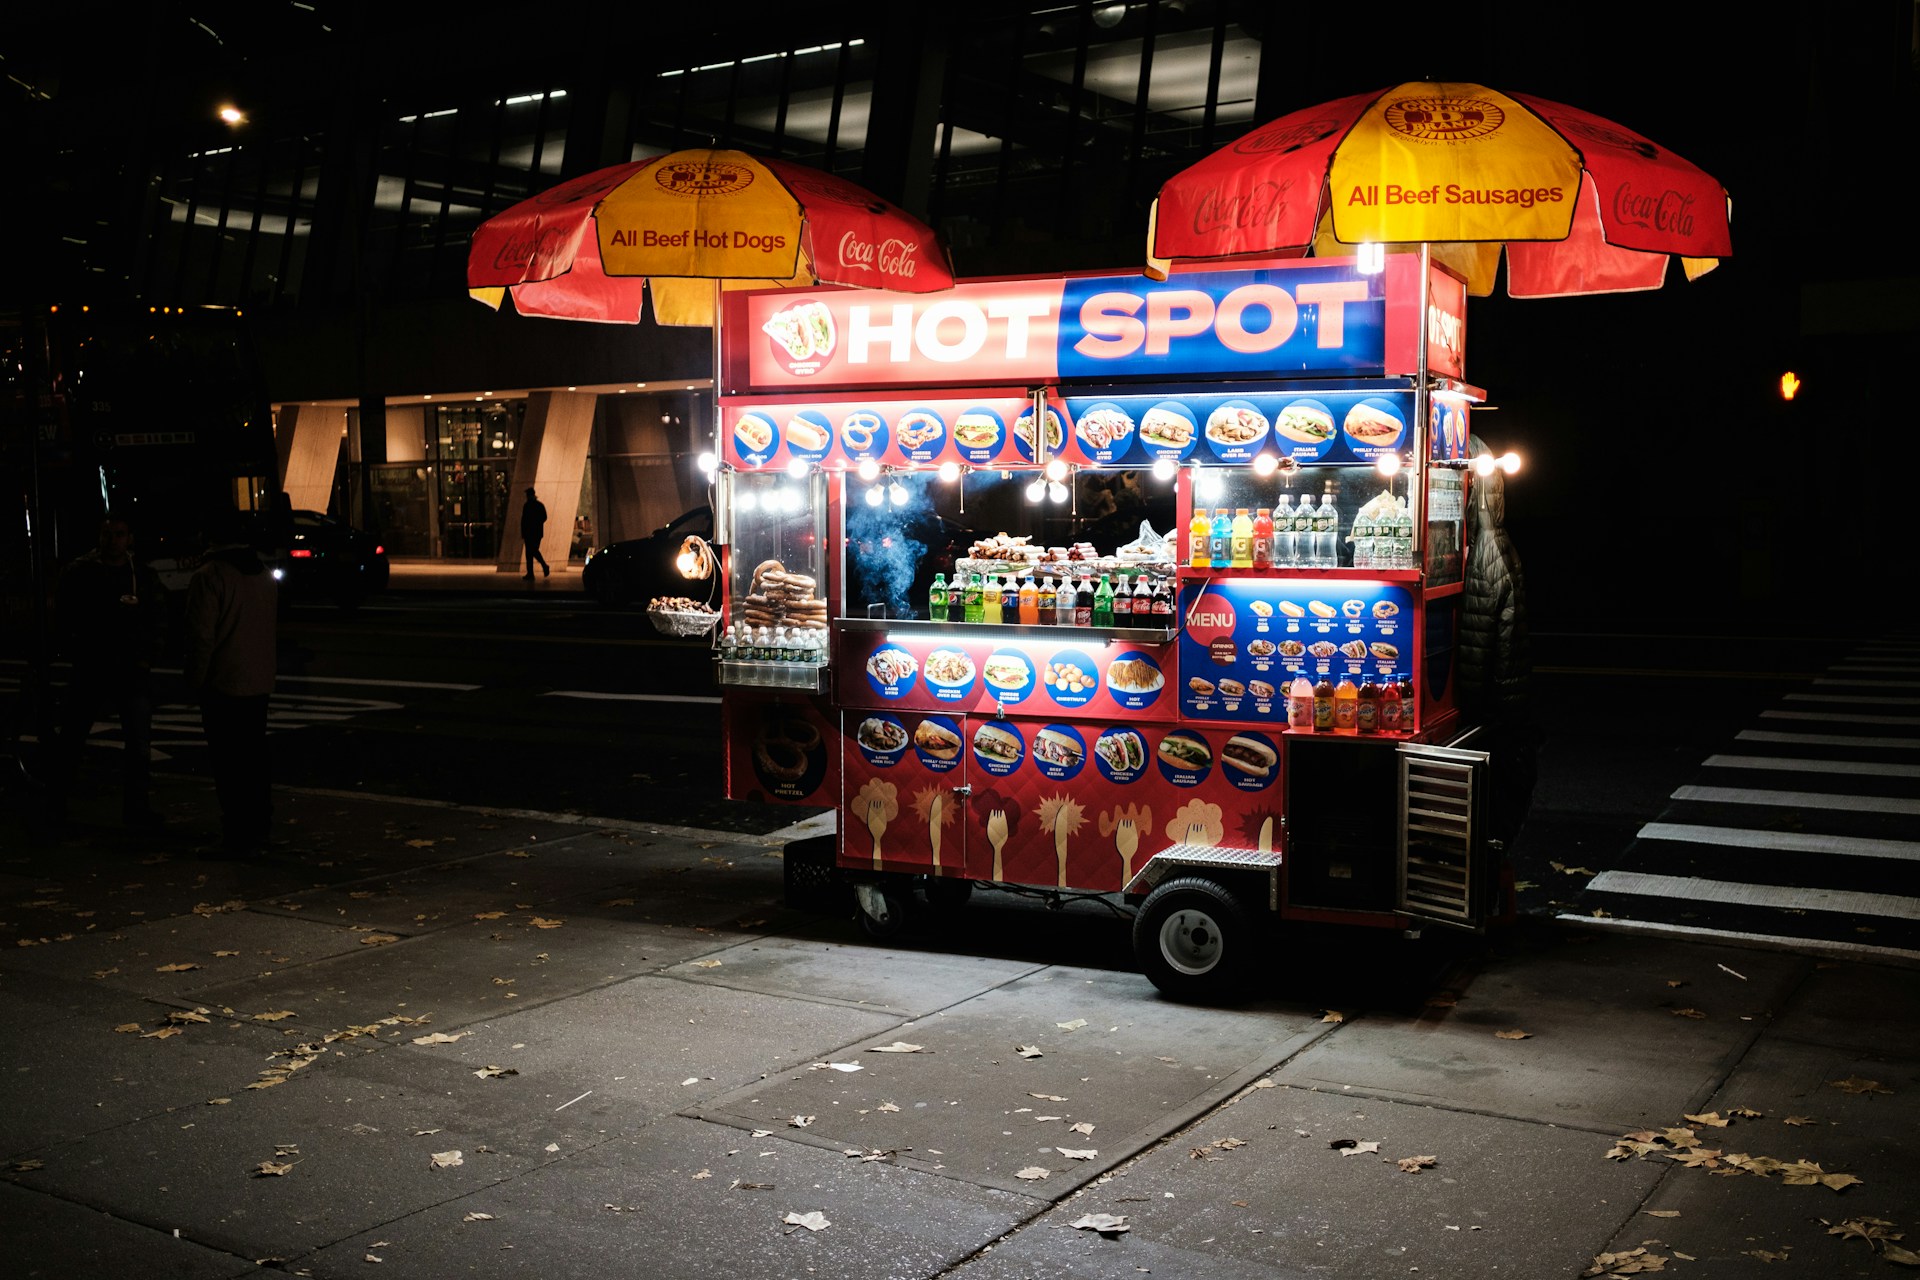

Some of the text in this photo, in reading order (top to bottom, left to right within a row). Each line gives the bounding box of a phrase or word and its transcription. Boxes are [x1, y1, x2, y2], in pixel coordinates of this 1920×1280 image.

[1399, 101, 1482, 112] GOLDEN
[1411, 120, 1479, 132] BRAND
[672, 180, 732, 189] BRAND
[1348, 184, 1563, 209] All Beef Sausages
[1613, 181, 1696, 237] Coca-Cola
[610, 229, 786, 253] All Beef Hot Dogs
[838, 231, 919, 278] Coca-Cola
[848, 281, 1368, 364] HOT SPOT
[1186, 612, 1234, 628] MENU
